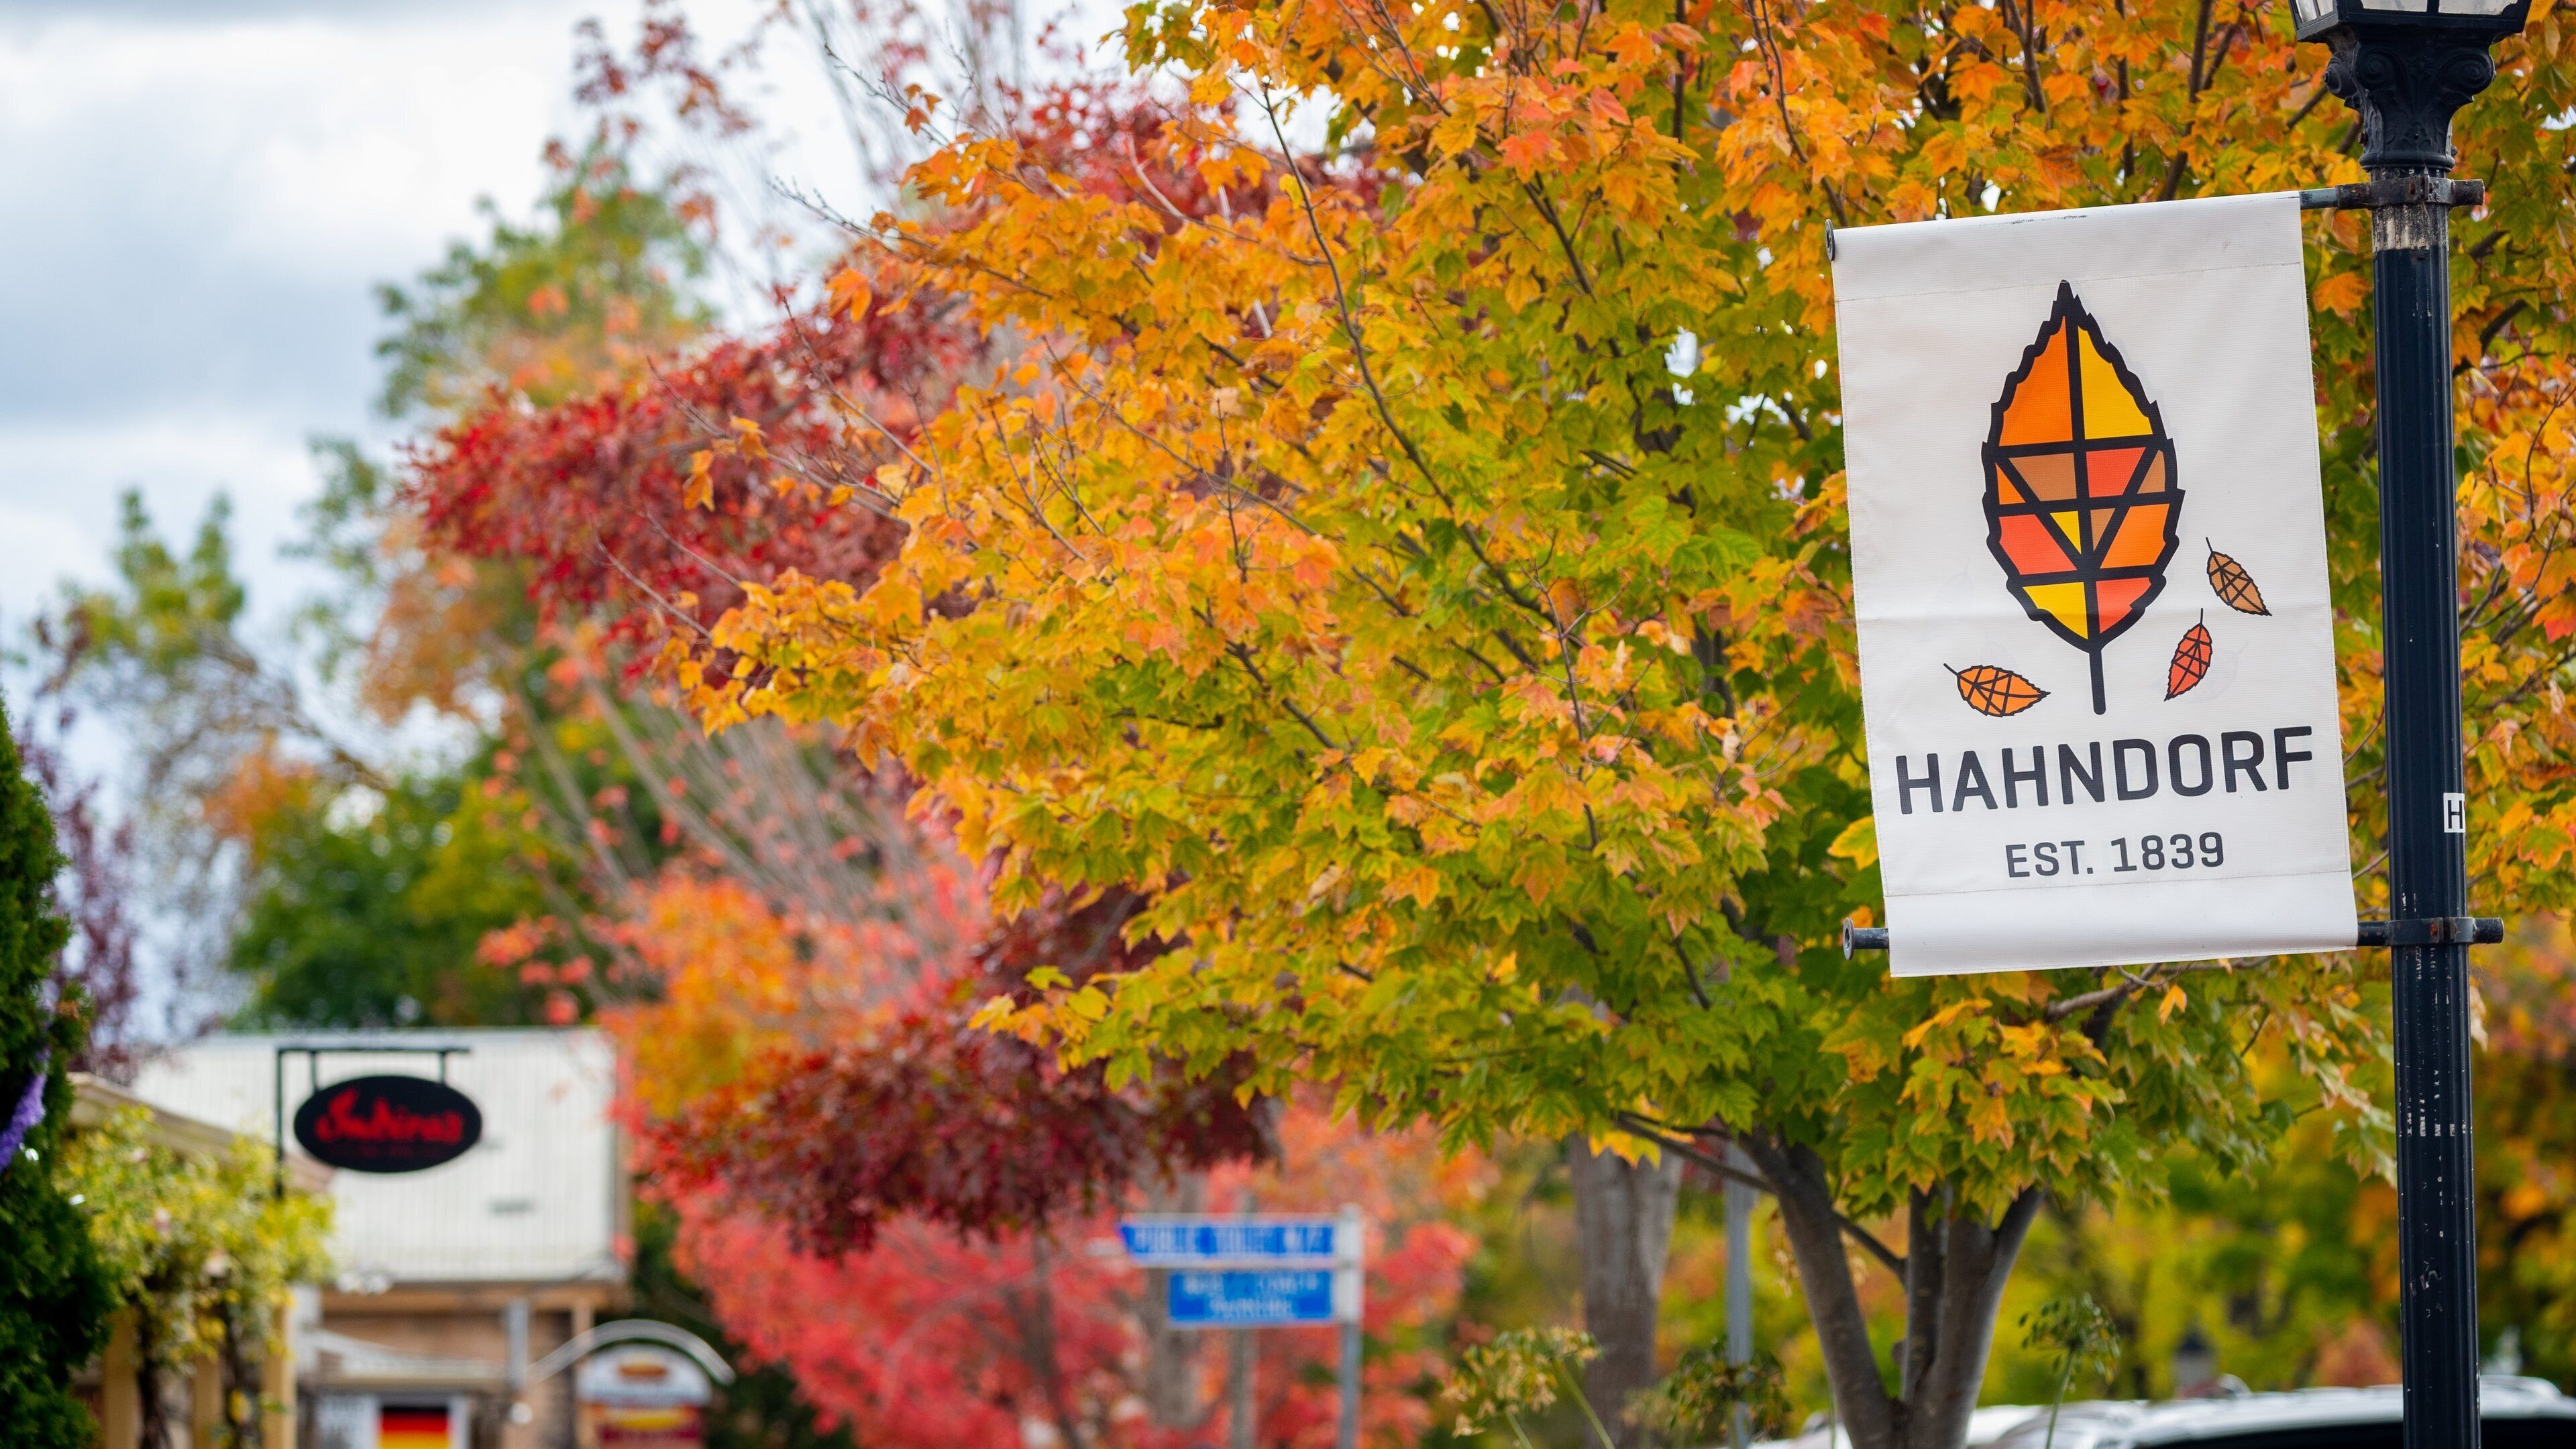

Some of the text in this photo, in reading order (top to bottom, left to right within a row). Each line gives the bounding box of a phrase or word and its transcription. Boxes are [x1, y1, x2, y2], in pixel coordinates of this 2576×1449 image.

[1896, 726, 2313, 814] HAHNDORF
[2447, 800, 2463, 829] H
[2005, 832, 2224, 878] EST. 1839
